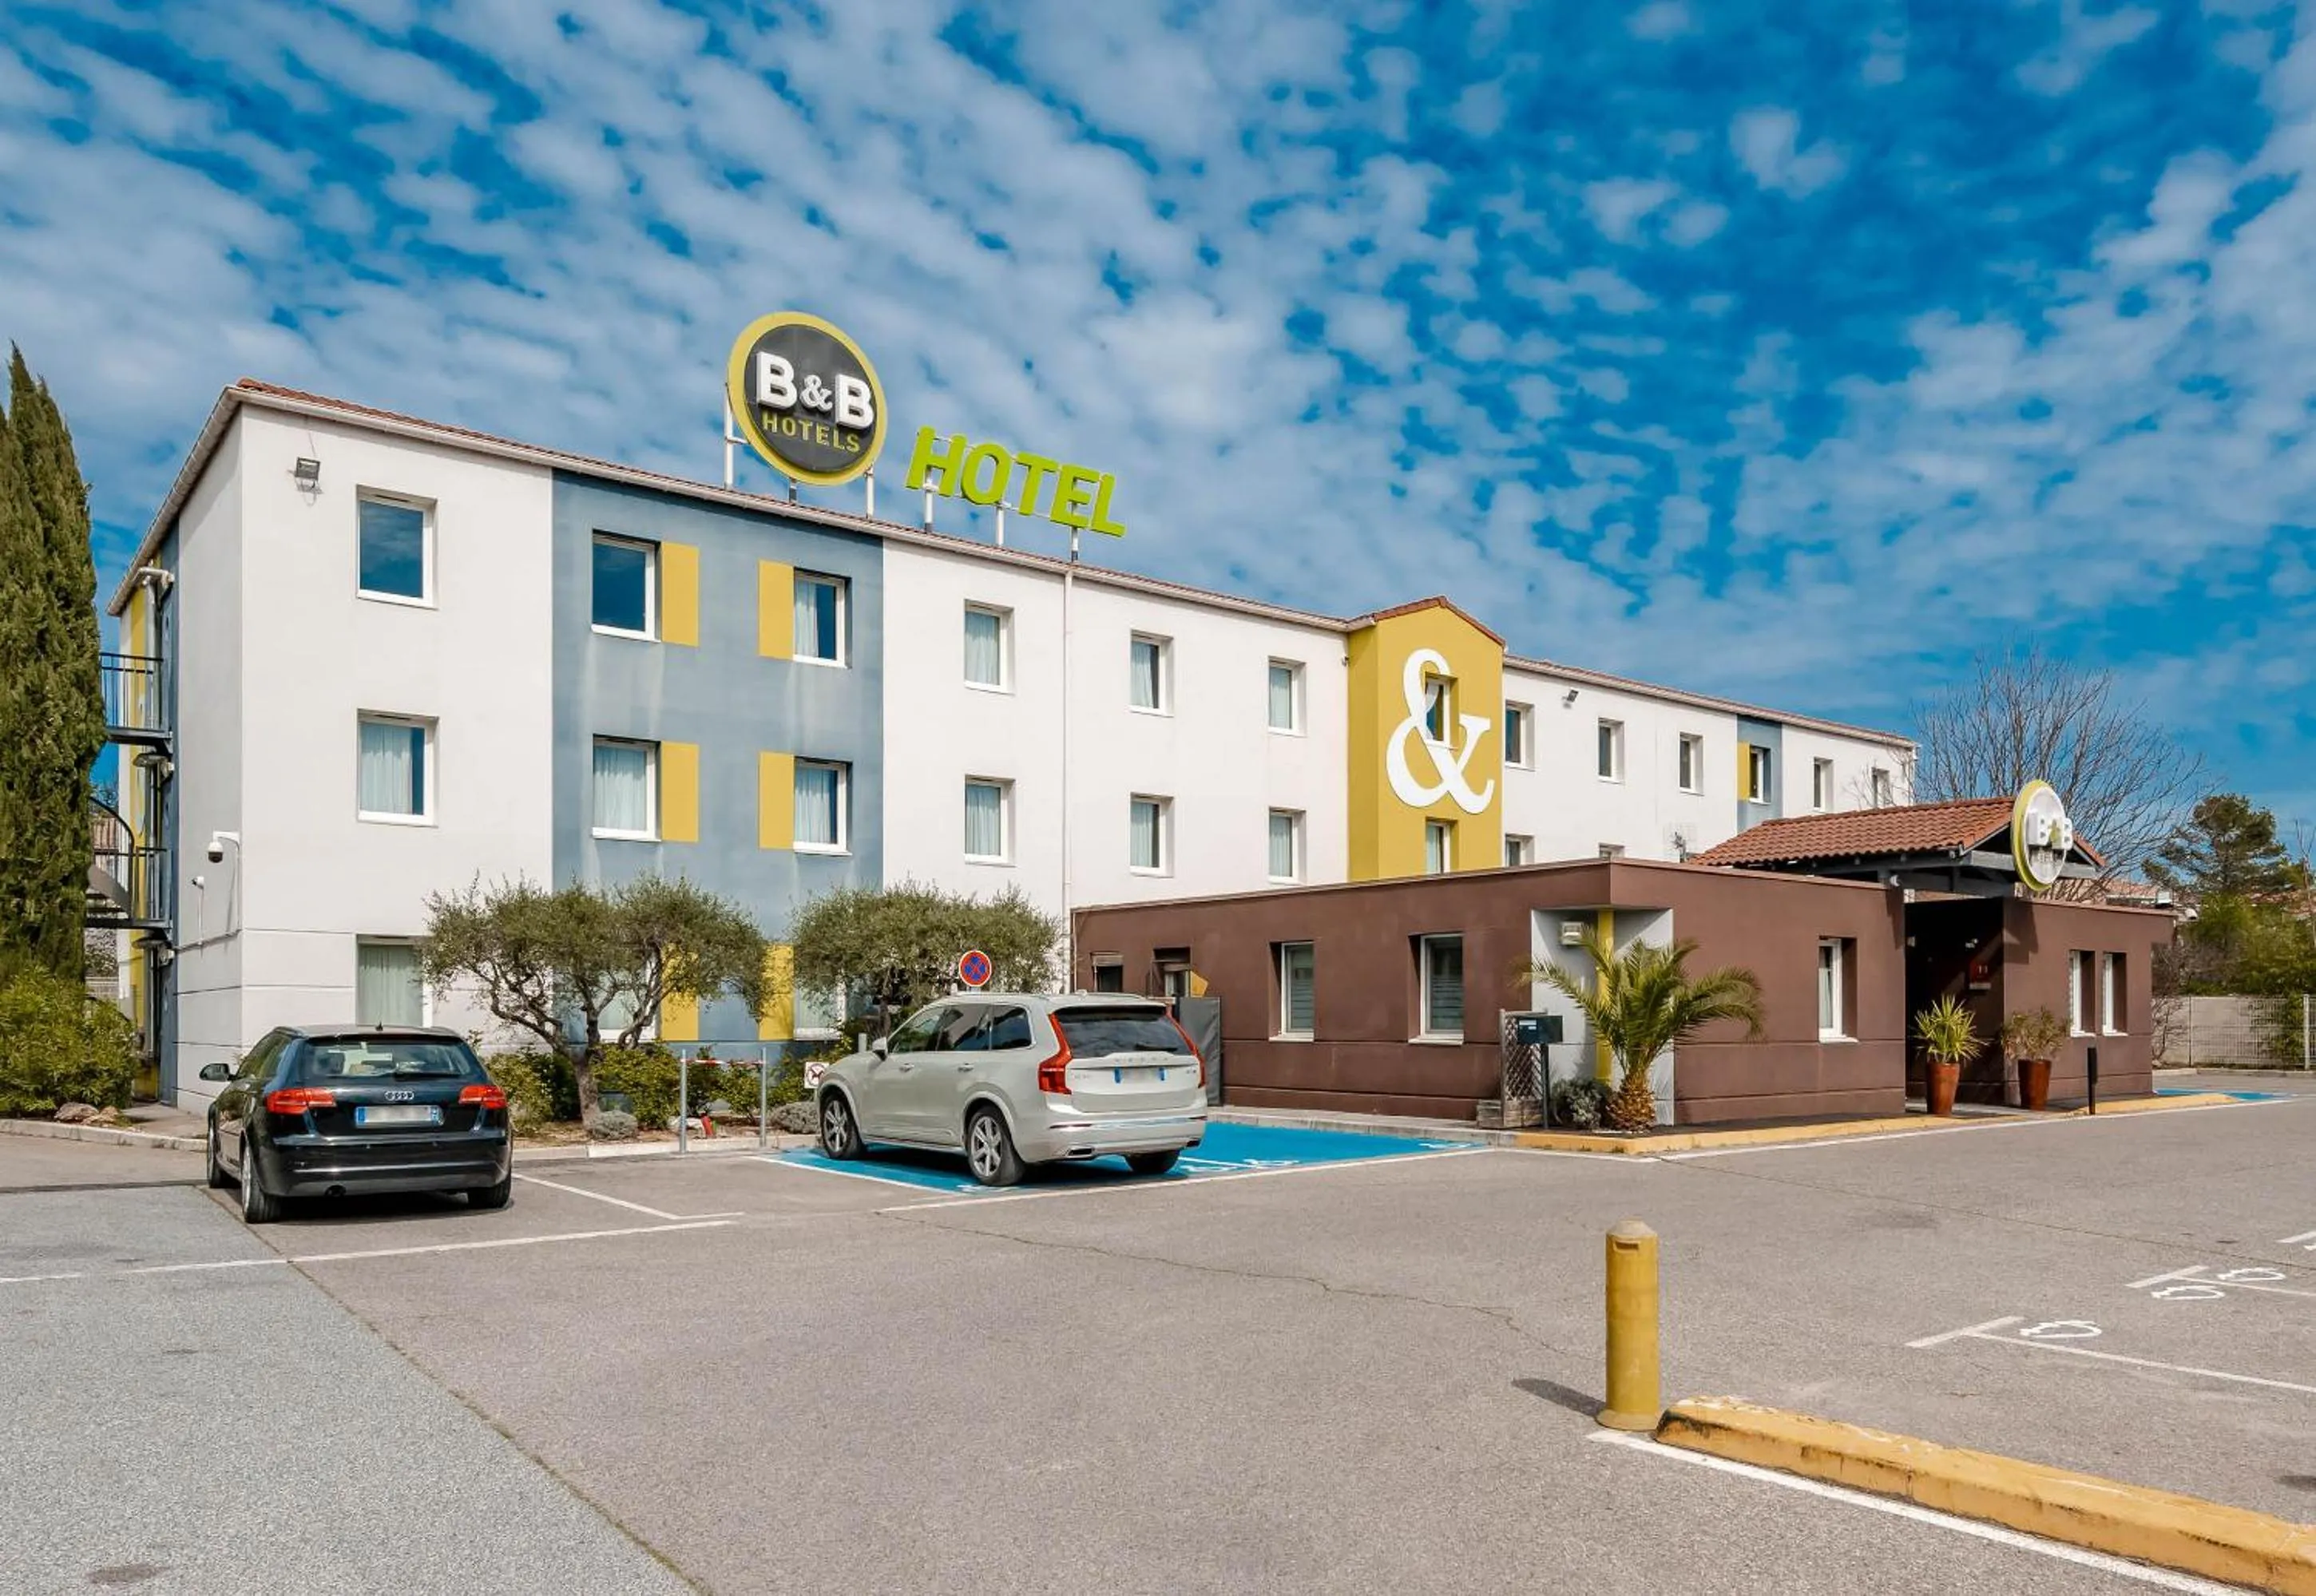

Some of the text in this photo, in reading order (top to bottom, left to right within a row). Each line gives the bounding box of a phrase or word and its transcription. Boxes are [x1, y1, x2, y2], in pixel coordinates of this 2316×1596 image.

[756, 351, 874, 430] B&B
[762, 411, 860, 453] HOTELS
[906, 426, 1125, 537] HOTEL
[1386, 648, 1495, 815] &
